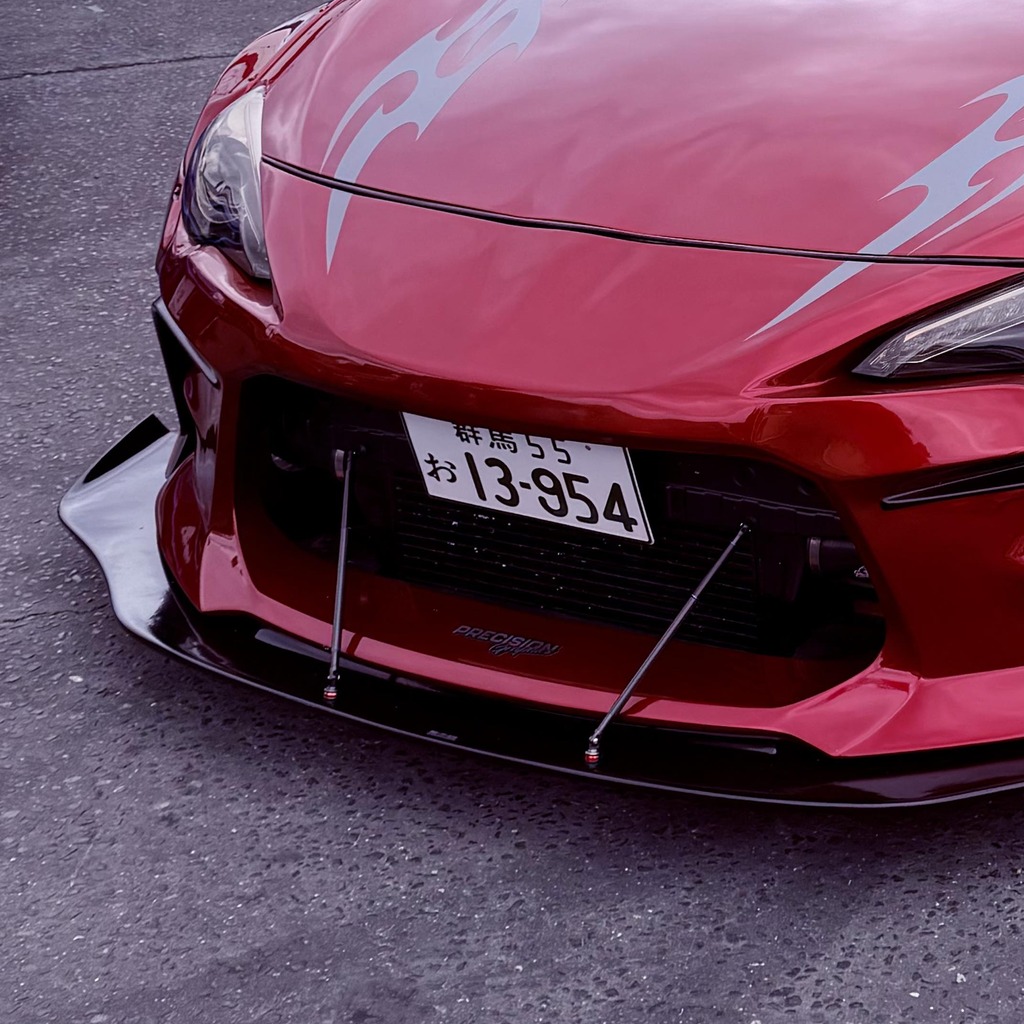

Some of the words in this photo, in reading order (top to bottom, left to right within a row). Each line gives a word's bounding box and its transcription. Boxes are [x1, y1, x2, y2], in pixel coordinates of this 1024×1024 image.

[424, 452, 457, 483] お
[464, 451, 639, 533] 13-954
[452, 625, 560, 655] PRECISION
